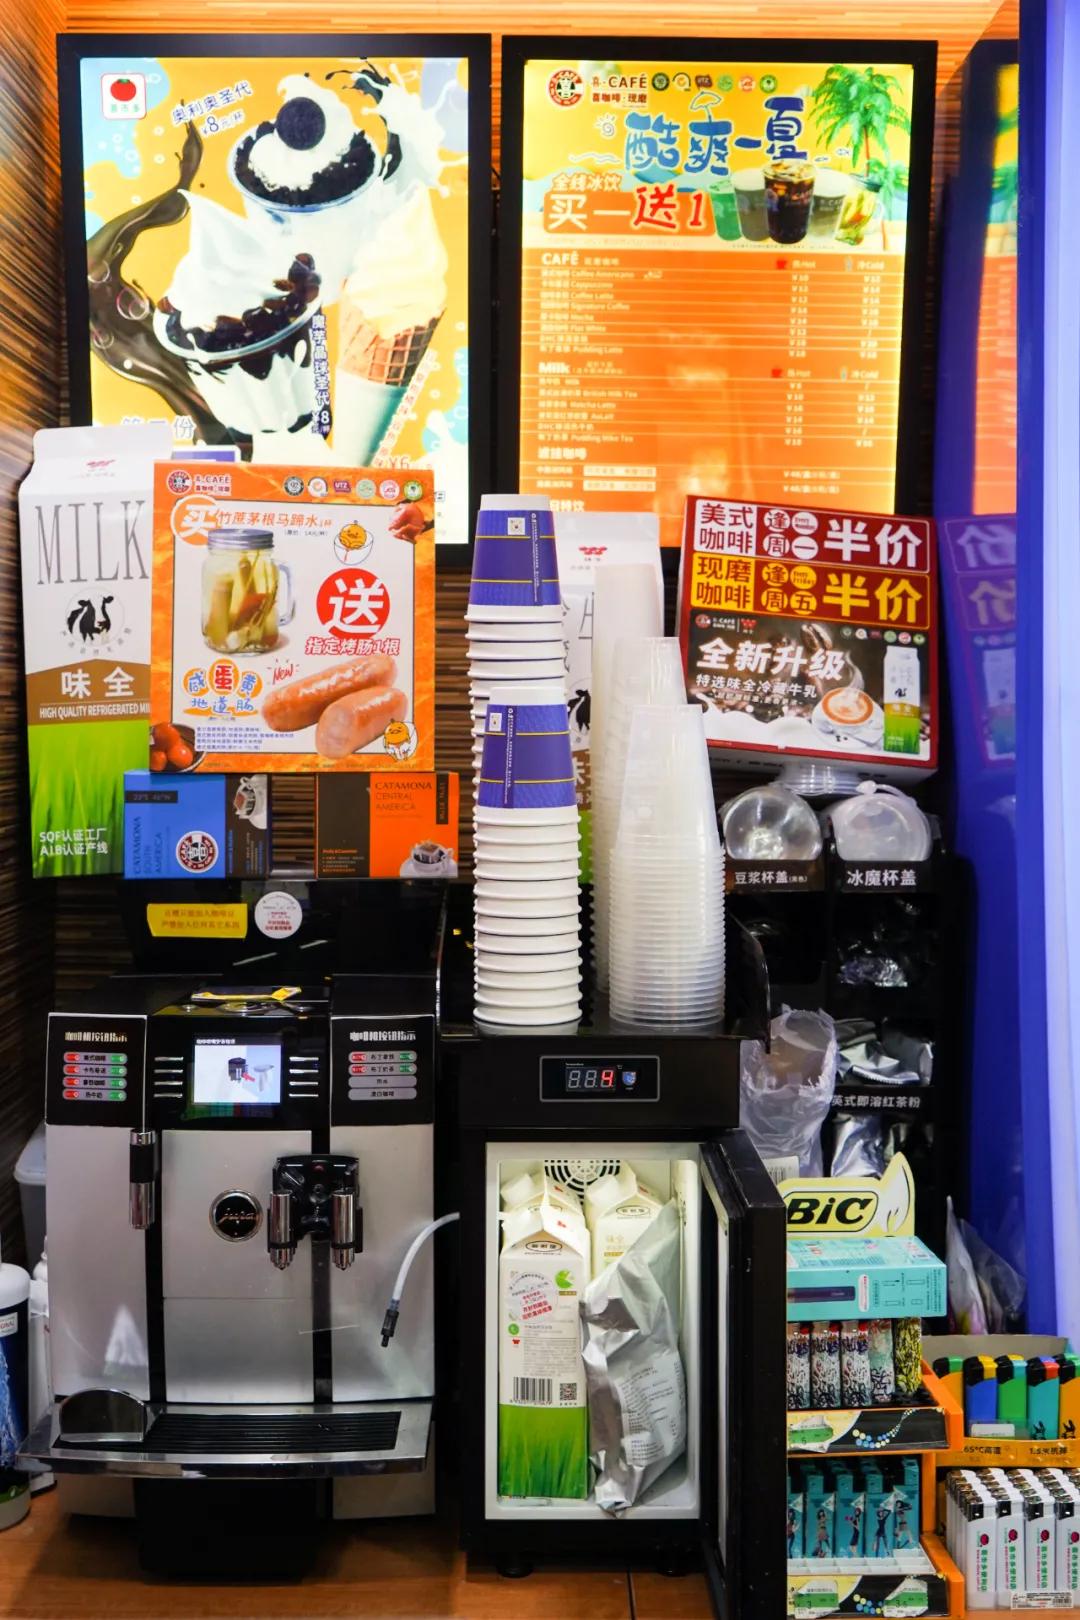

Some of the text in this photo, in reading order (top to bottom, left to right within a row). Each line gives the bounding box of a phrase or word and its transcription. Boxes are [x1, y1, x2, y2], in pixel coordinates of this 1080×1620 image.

[172, 81, 252, 124] 奥利奥圣代
[625, 98, 807, 176] 酷爽一夏
[700, 503, 753, 528] 美式
[767, 511, 788, 530] 逢
[35, 500, 149, 584] MILK
[699, 528, 753, 554] 咖啡
[824, 518, 922, 568] 半价
[696, 557, 752, 583] 现磨
[322, 577, 384, 635] 送
[696, 583, 752, 609] 咖啡
[822, 573, 922, 623] 半价
[696, 637, 846, 682] 全新升级
[61, 666, 135, 699] 味全
[39, 707, 57, 719] HIGH
[375, 781, 432, 790] CATAMONA
[847, 869, 917, 887] 冰魔杯盖
